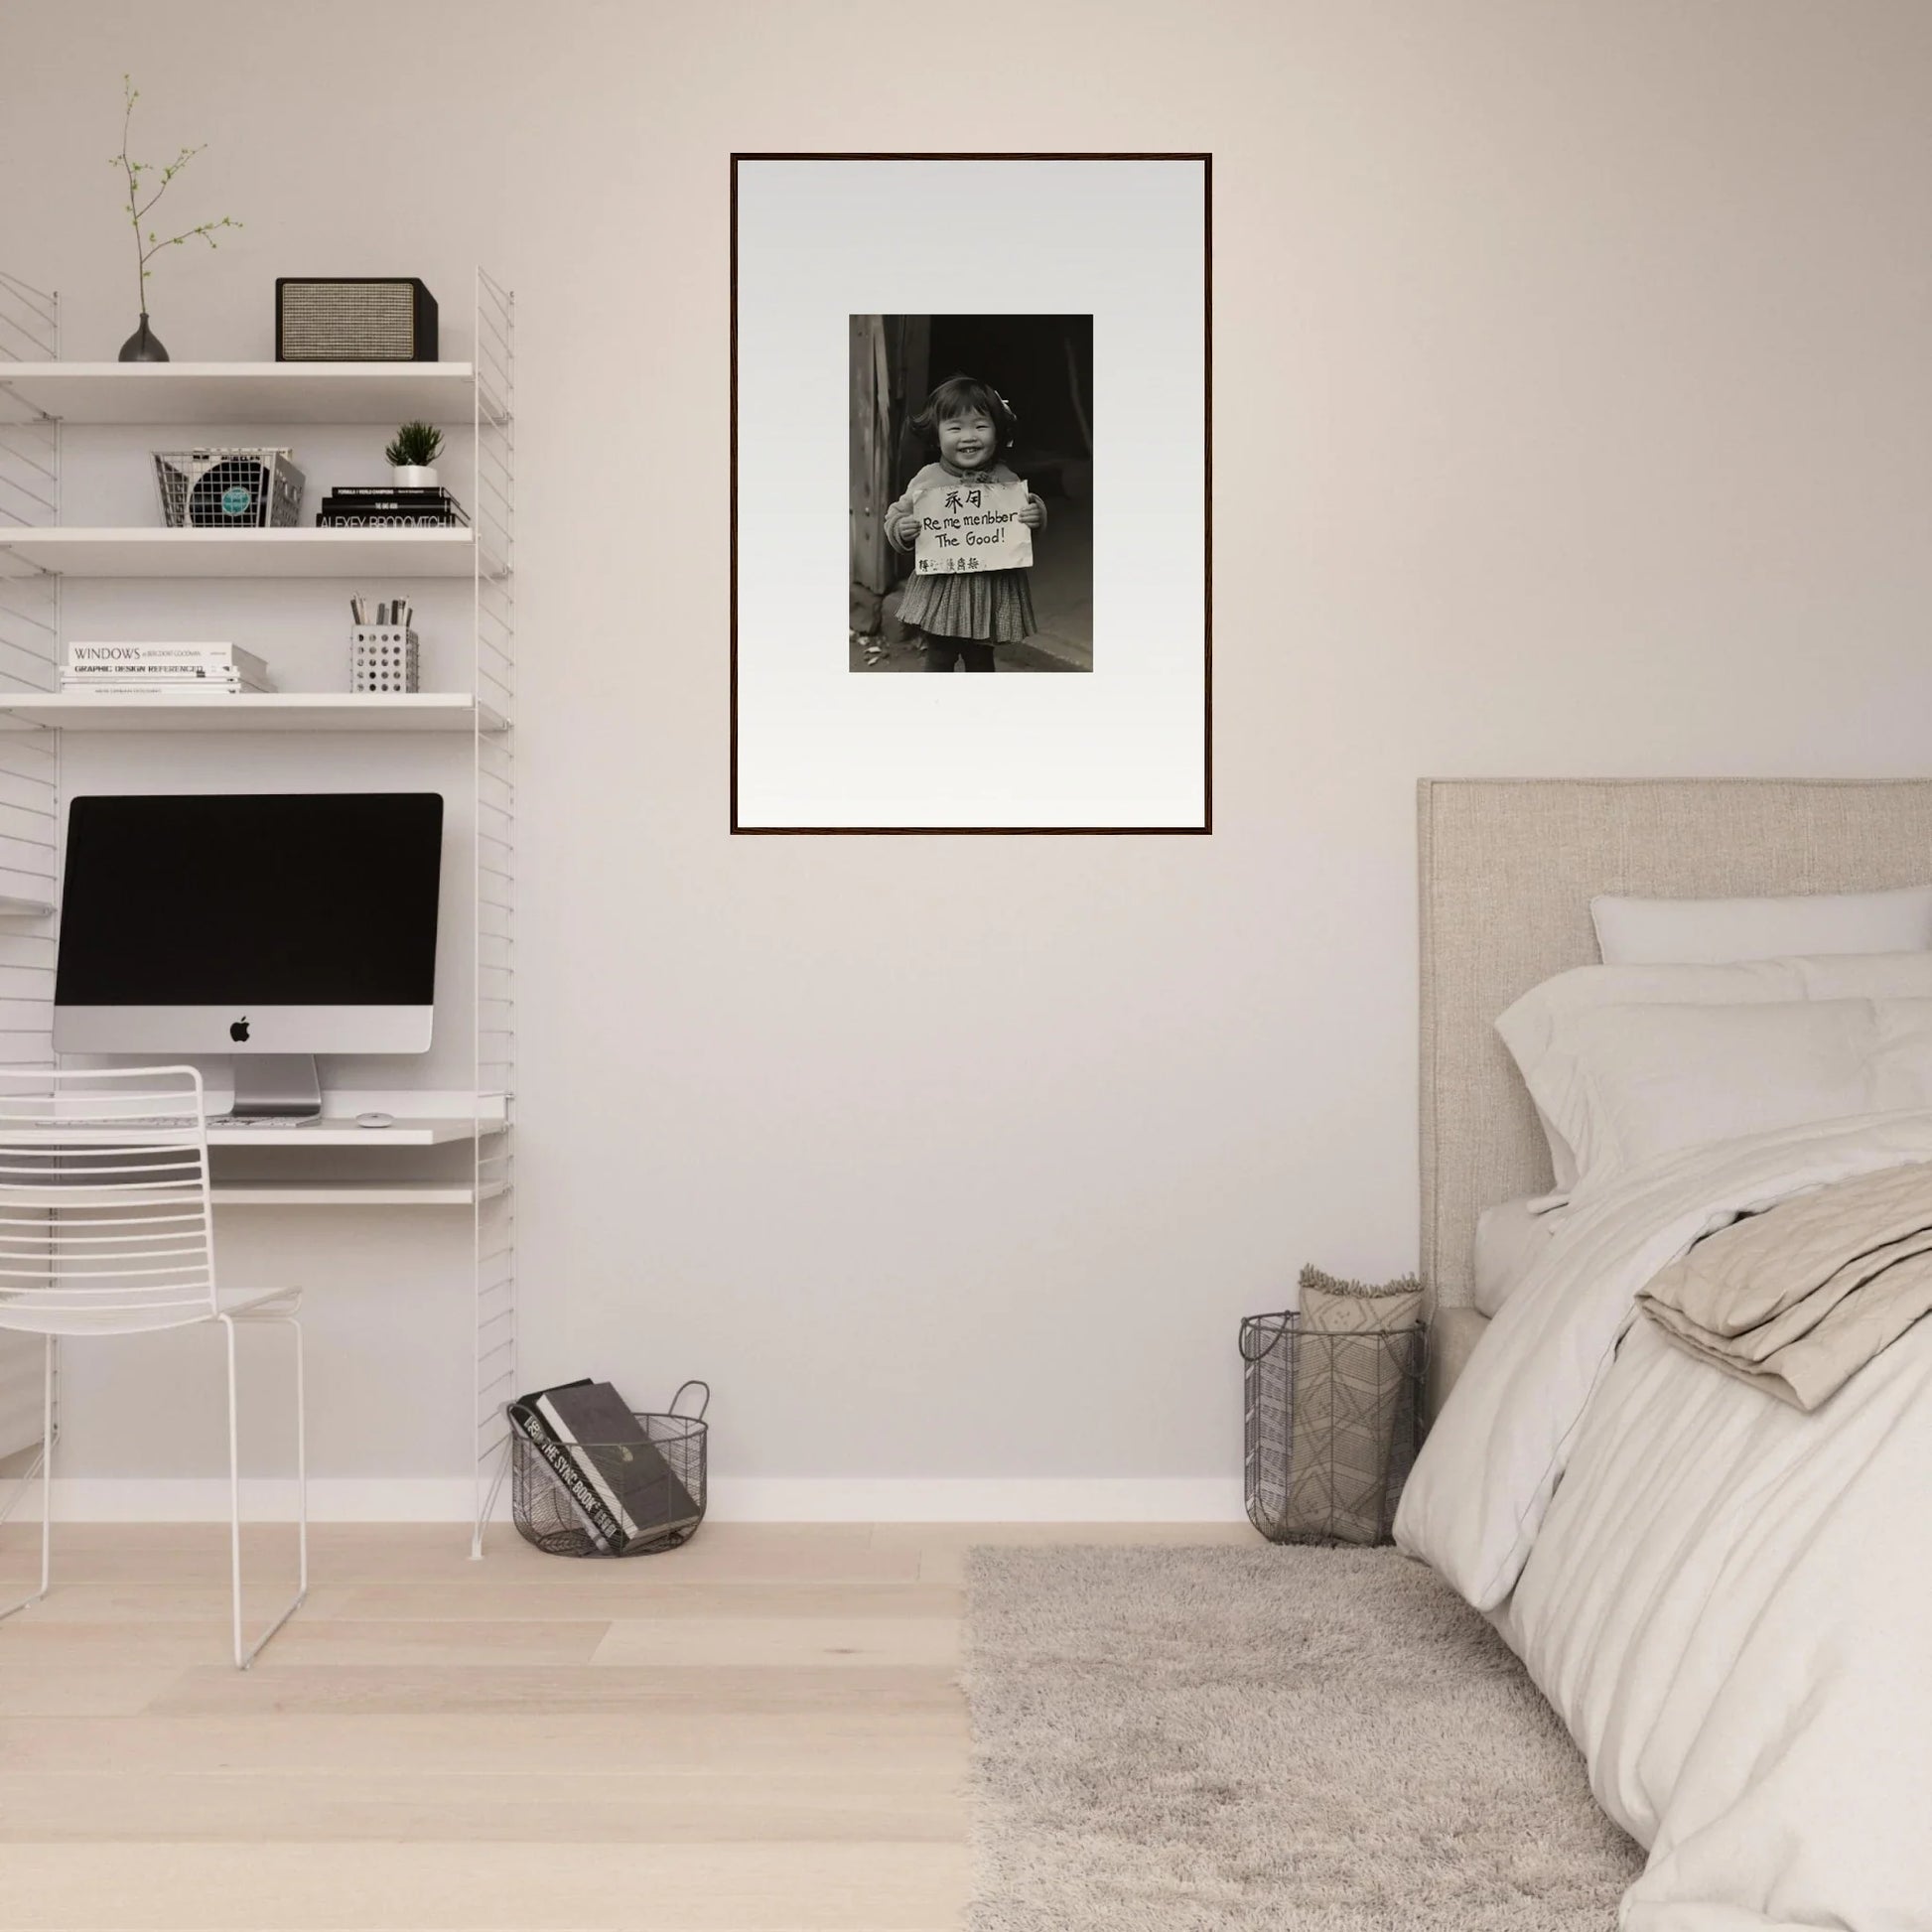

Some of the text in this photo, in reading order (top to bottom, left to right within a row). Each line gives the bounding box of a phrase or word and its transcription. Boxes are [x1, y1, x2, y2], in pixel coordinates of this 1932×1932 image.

[934, 527, 1005, 548] The Good!
[74, 647, 141, 660] WINDOWS
[554, 1455, 578, 1485] SYNC
